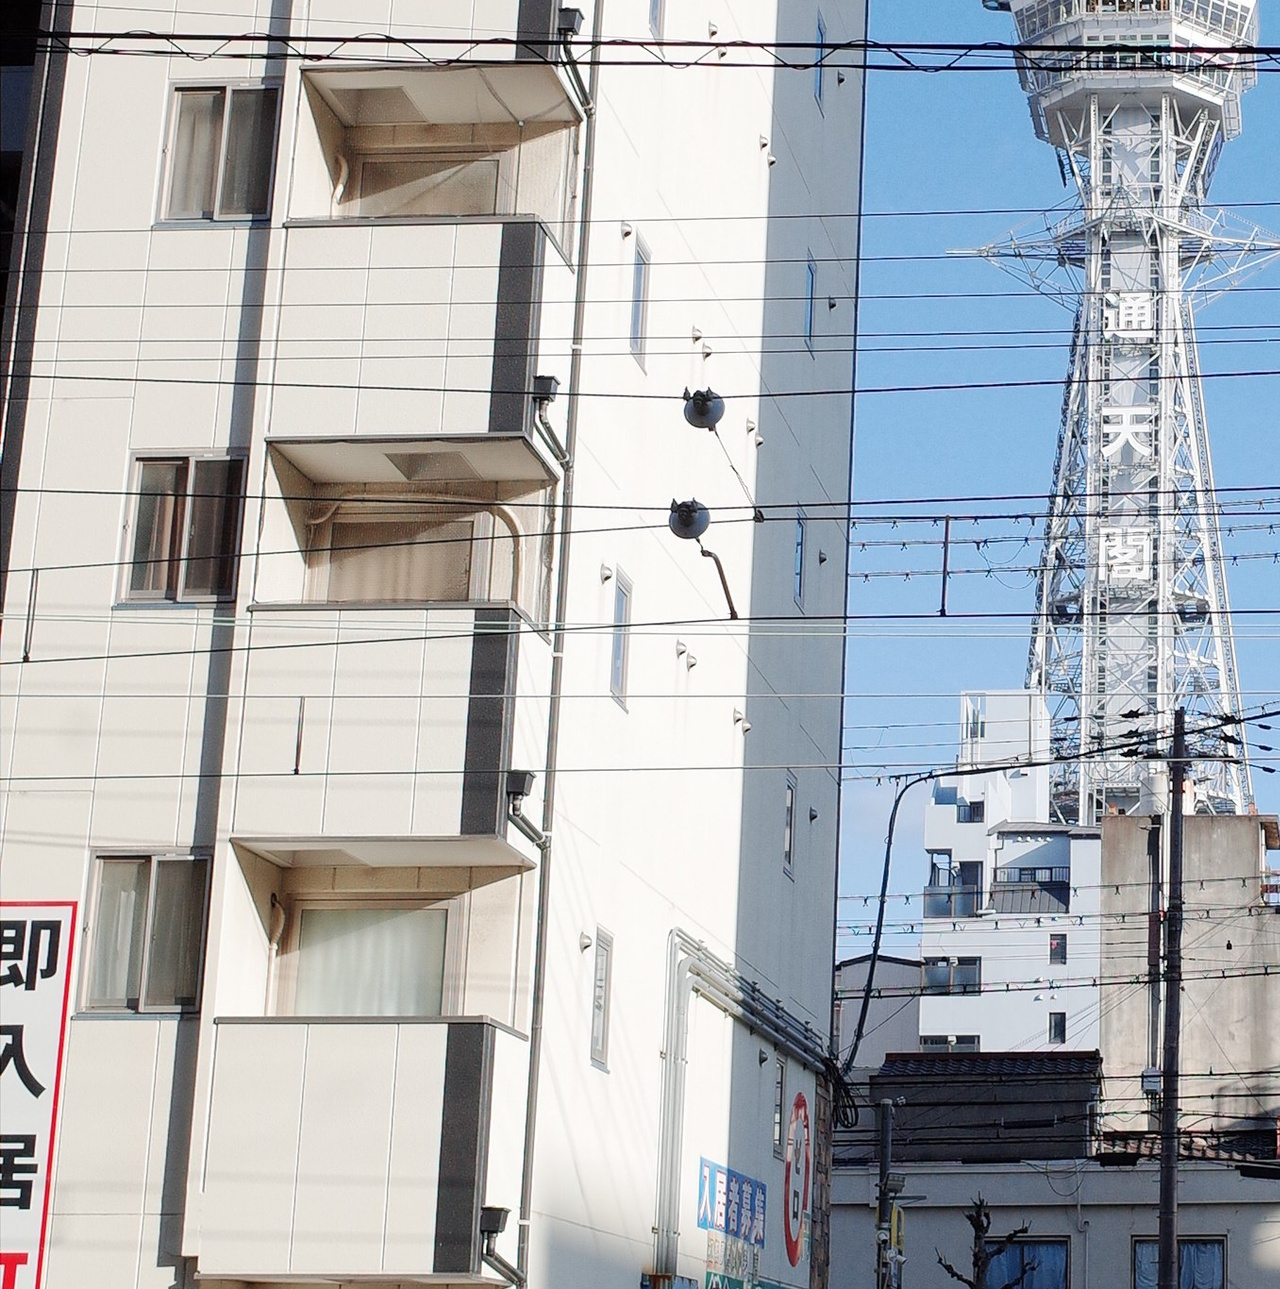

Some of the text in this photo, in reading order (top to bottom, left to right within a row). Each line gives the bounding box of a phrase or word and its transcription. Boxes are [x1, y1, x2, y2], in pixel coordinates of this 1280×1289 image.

[1100, 290, 1154, 580] 通天閣
[700, 1165, 765, 1244] 入居者募集
